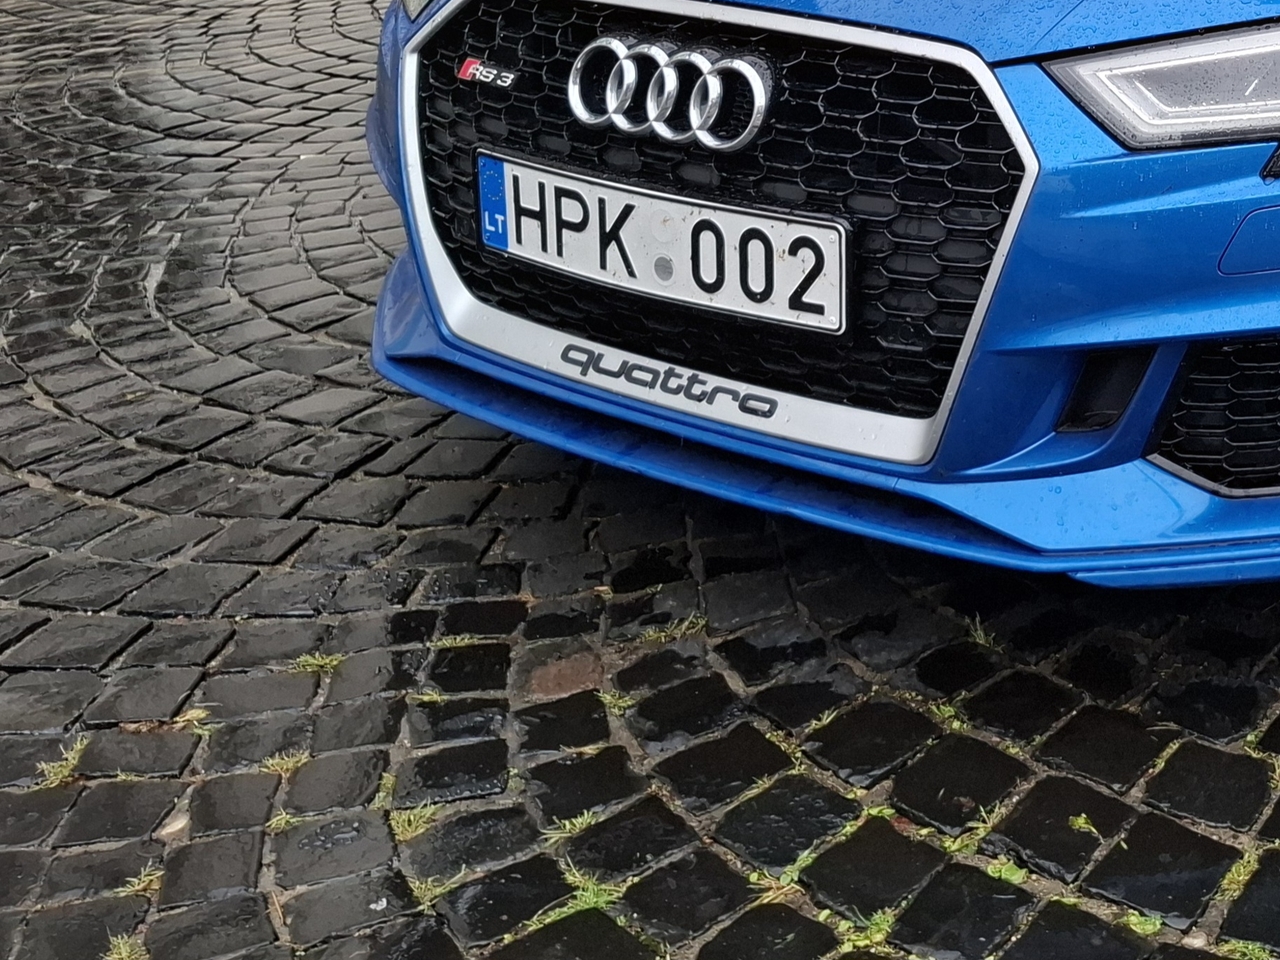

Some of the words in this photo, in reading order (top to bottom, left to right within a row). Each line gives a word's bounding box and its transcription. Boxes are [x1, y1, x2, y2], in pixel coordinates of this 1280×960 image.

[466, 63, 498, 83] RS
[496, 72, 515, 87] 3
[484, 210, 505, 234] LT
[511, 173, 638, 279] HPK
[690, 217, 826, 316] 002
[560, 343, 779, 419] quattro
